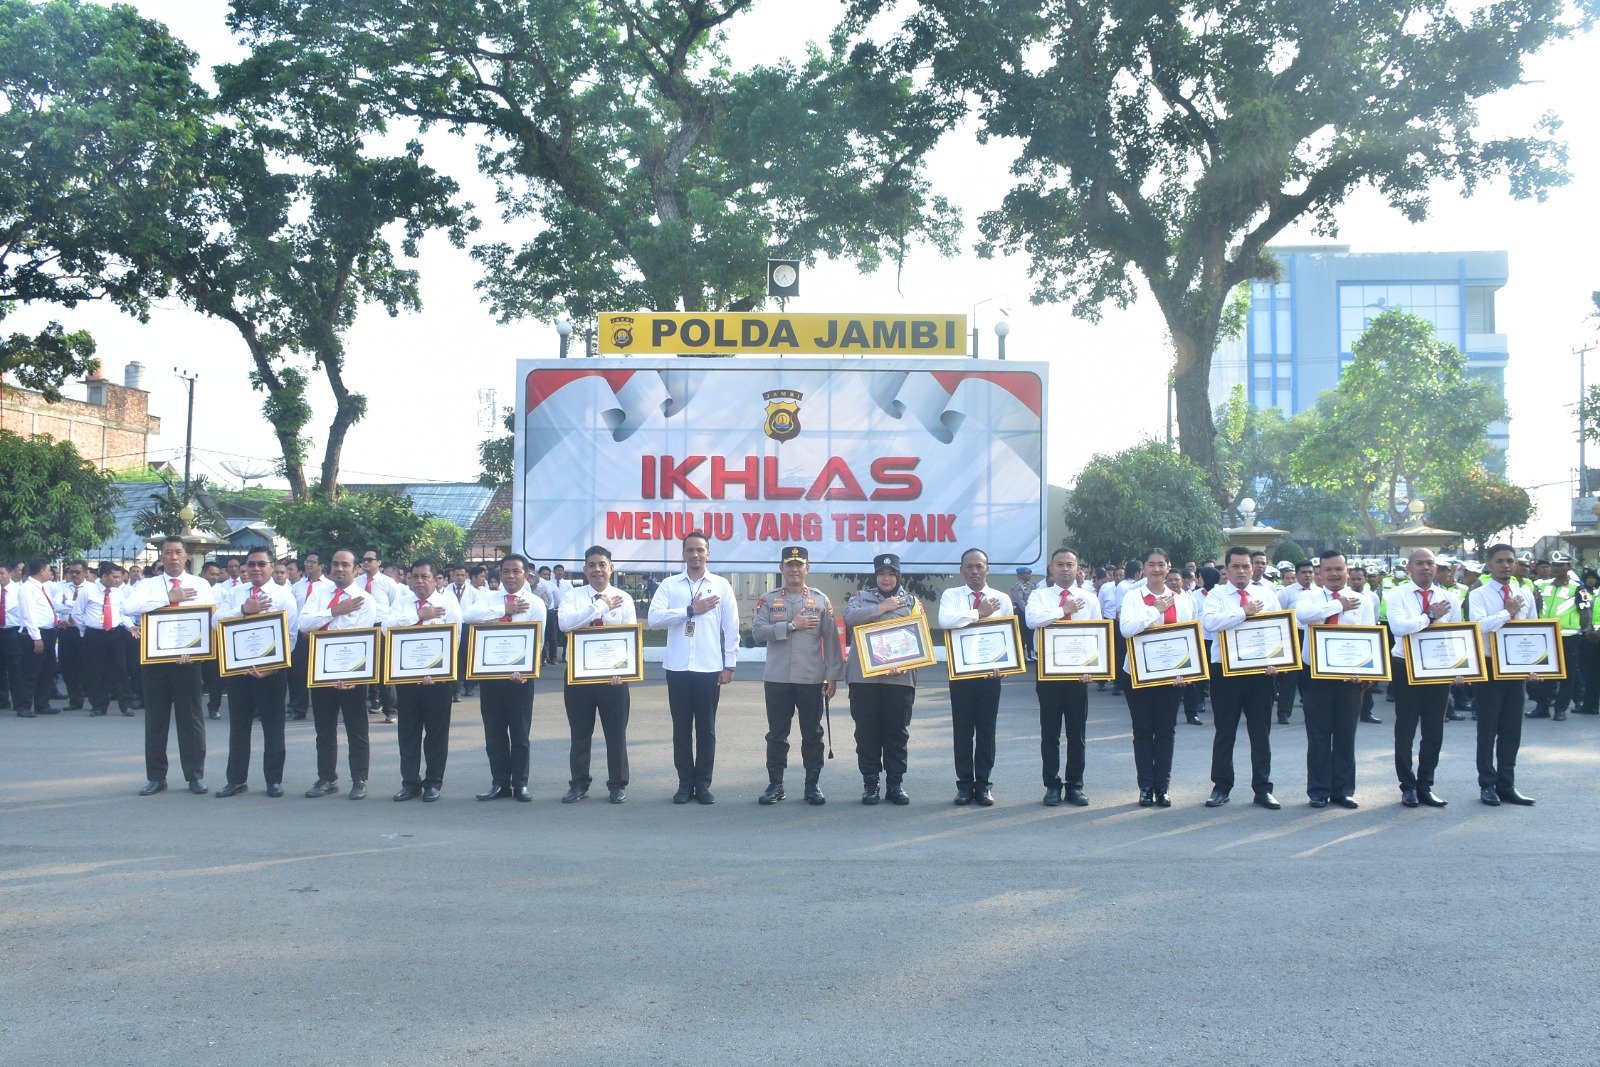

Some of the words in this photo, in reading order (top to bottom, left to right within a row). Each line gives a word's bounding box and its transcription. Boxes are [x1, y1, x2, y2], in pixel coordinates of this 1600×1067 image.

[651, 318, 800, 348] POLDA
[813, 320, 955, 349] JAMBI
[641, 455, 922, 501] IKHLAS
[606, 511, 734, 541] MENUJU
[742, 512, 823, 542] YANG
[831, 513, 958, 542] TERBAIK
